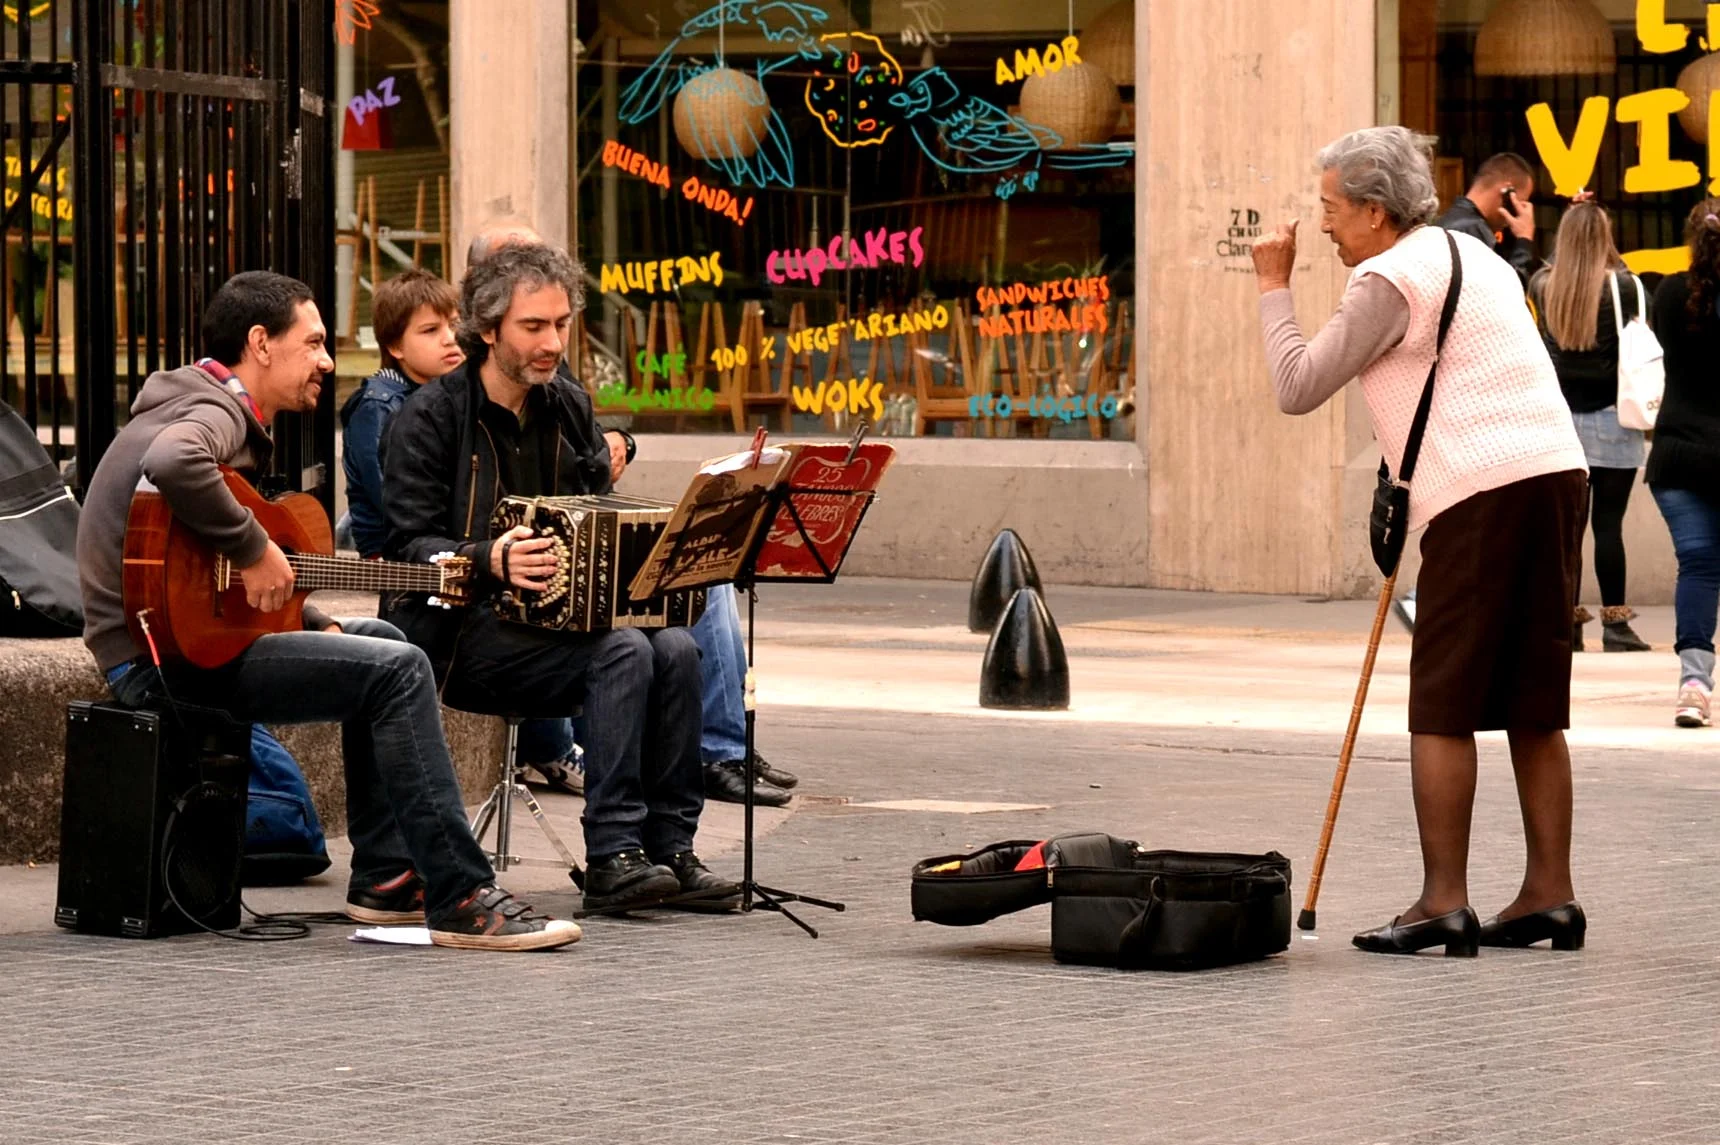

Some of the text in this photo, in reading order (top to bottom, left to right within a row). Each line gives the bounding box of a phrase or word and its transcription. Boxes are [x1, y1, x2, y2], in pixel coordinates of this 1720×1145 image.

[996, 35, 1083, 85] AMOR
[348, 75, 401, 126] PAZ
[602, 140, 753, 226] BUENA ONDA!
[1231, 208, 1260, 226] 7 D
[600, 251, 723, 294] MUFFINS
[766, 226, 924, 286] CUPCAKES
[976, 275, 1109, 312] SANDWICHES
[979, 303, 1108, 338] NATURALES
[711, 344, 748, 372] 100
[792, 377, 884, 421] WOKS
[813, 467, 845, 482] 25
